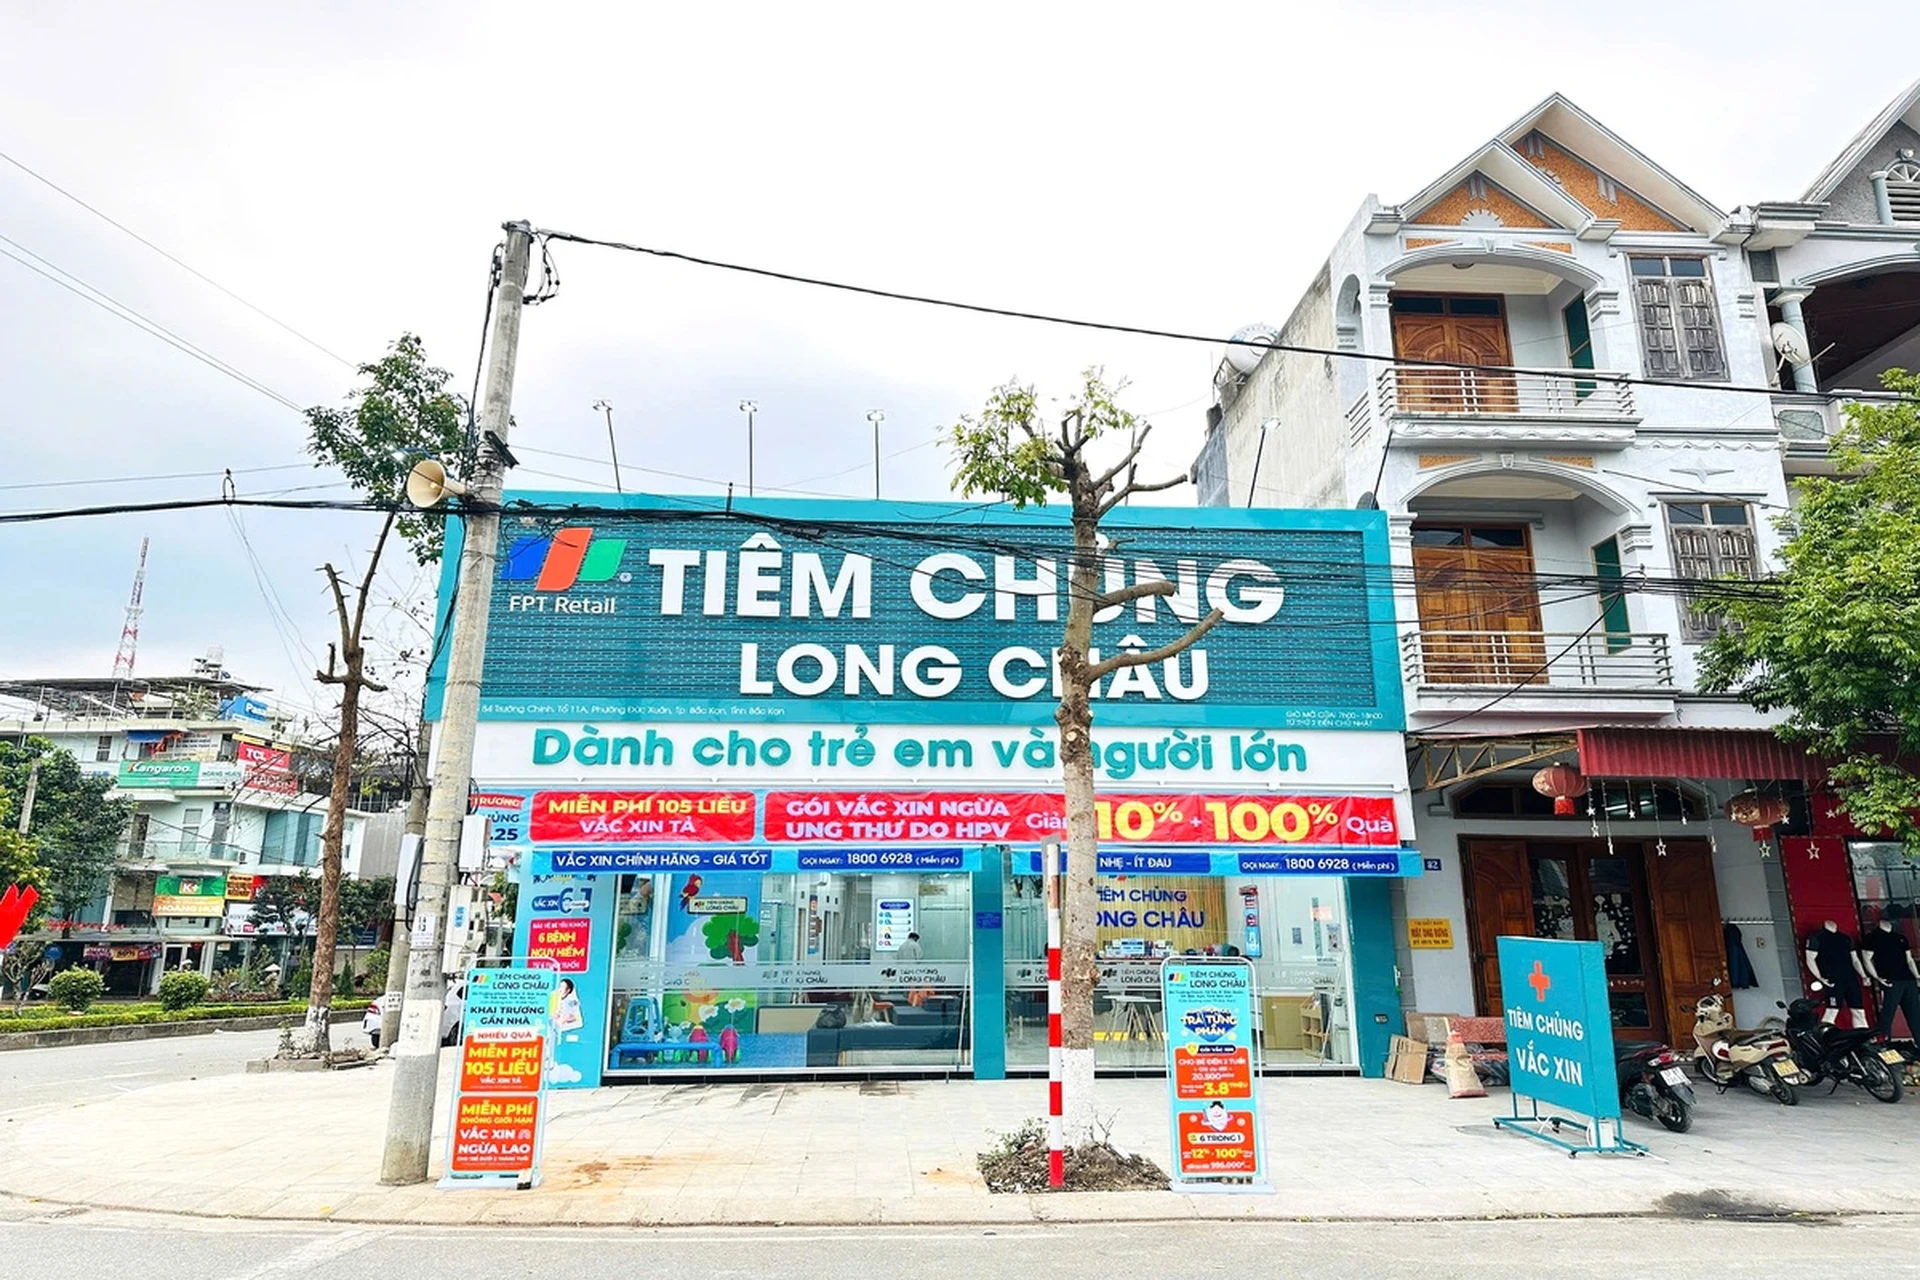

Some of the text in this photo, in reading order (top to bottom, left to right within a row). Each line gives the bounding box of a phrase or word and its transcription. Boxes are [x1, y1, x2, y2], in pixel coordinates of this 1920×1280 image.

[650, 532, 872, 619] TIÊM
[509, 596, 616, 615] FPT Retail
[740, 642, 962, 698] LONG
[246, 748, 265, 762] TCL
[534, 724, 1307, 780] Dành cho trẻ em và gười lớn
[128, 761, 191, 778] Kangaroo
[549, 794, 747, 815] MIỄN PHÍ 105 LIỀU
[786, 796, 1011, 817] GÓI VẮC XIN NGỪA
[488, 811, 520, 823] ỦNG
[580, 816, 697, 834] VẮC XIN TẢ
[1025, 811, 1067, 829] Giả
[1095, 800, 1184, 841] 10%
[1205, 801, 1339, 842] 100%
[1346, 811, 1395, 835] Quà
[786, 819, 1011, 839] UNG THƯ DO HPV
[556, 851, 588, 867] VẮC
[590, 855, 613, 867] XIN
[616, 851, 658, 867] CHÍNH
[660, 851, 700, 866] HÃNG
[713, 850, 737, 866] GIÁ
[741, 849, 768, 865] TỐT
[847, 853, 877, 865] 1800
[880, 853, 913, 865] 6928
[1099, 856, 1124, 869] NHẸ
[1133, 854, 1145, 868] ÍT
[1147, 857, 1172, 868] ĐAU
[1285, 857, 1313, 870] 1800
[1317, 857, 1350, 870] 6928
[1128, 885, 1187, 902] CHỦNG
[1096, 906, 1205, 928] NG CHÂU
[538, 930, 576, 945] 6 BỆNH
[492, 981, 520, 990] LONG
[1189, 980, 1218, 988] LONG
[1219, 978, 1246, 988] CHÂU
[470, 1005, 545, 1014] KHAI TRƯƠNG
[506, 1016, 530, 1025] NHÀ
[1506, 1005, 1584, 1041] TIÊM CHỦNG
[468, 1043, 538, 1058] MIỄN PHÍ
[465, 1061, 495, 1075] 105
[1516, 1039, 1583, 1087] VẮC XIN
[1204, 1082, 1230, 1095] 3.8
[461, 1099, 535, 1115] MIỄN PHÍ
[491, 1129, 516, 1139] XIN
[501, 1143, 531, 1154] LAO
